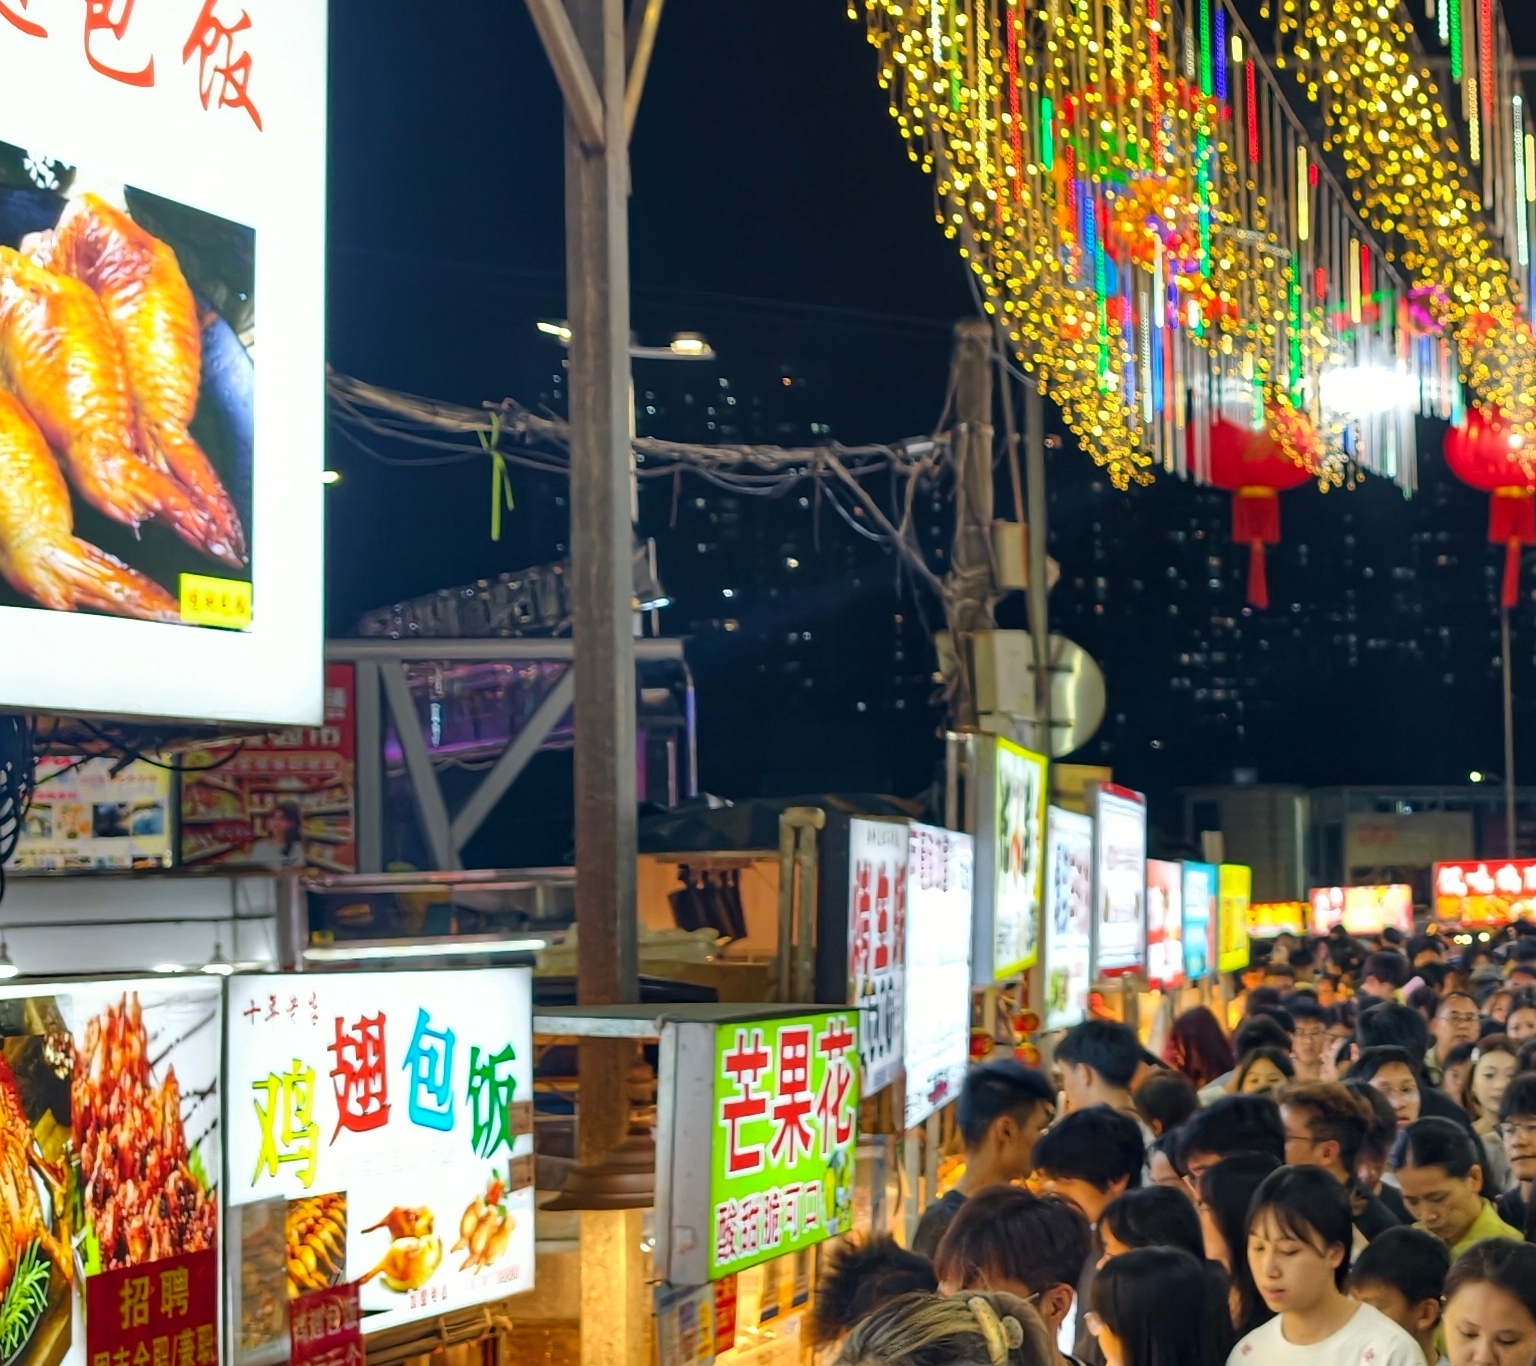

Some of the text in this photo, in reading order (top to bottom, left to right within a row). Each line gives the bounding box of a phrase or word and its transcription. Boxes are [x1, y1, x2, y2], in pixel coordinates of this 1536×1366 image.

[251, 1005, 517, 1189] 鸡翅包饭
[721, 1016, 853, 1175] 芒果花
[119, 1265, 190, 1330] 招聘
